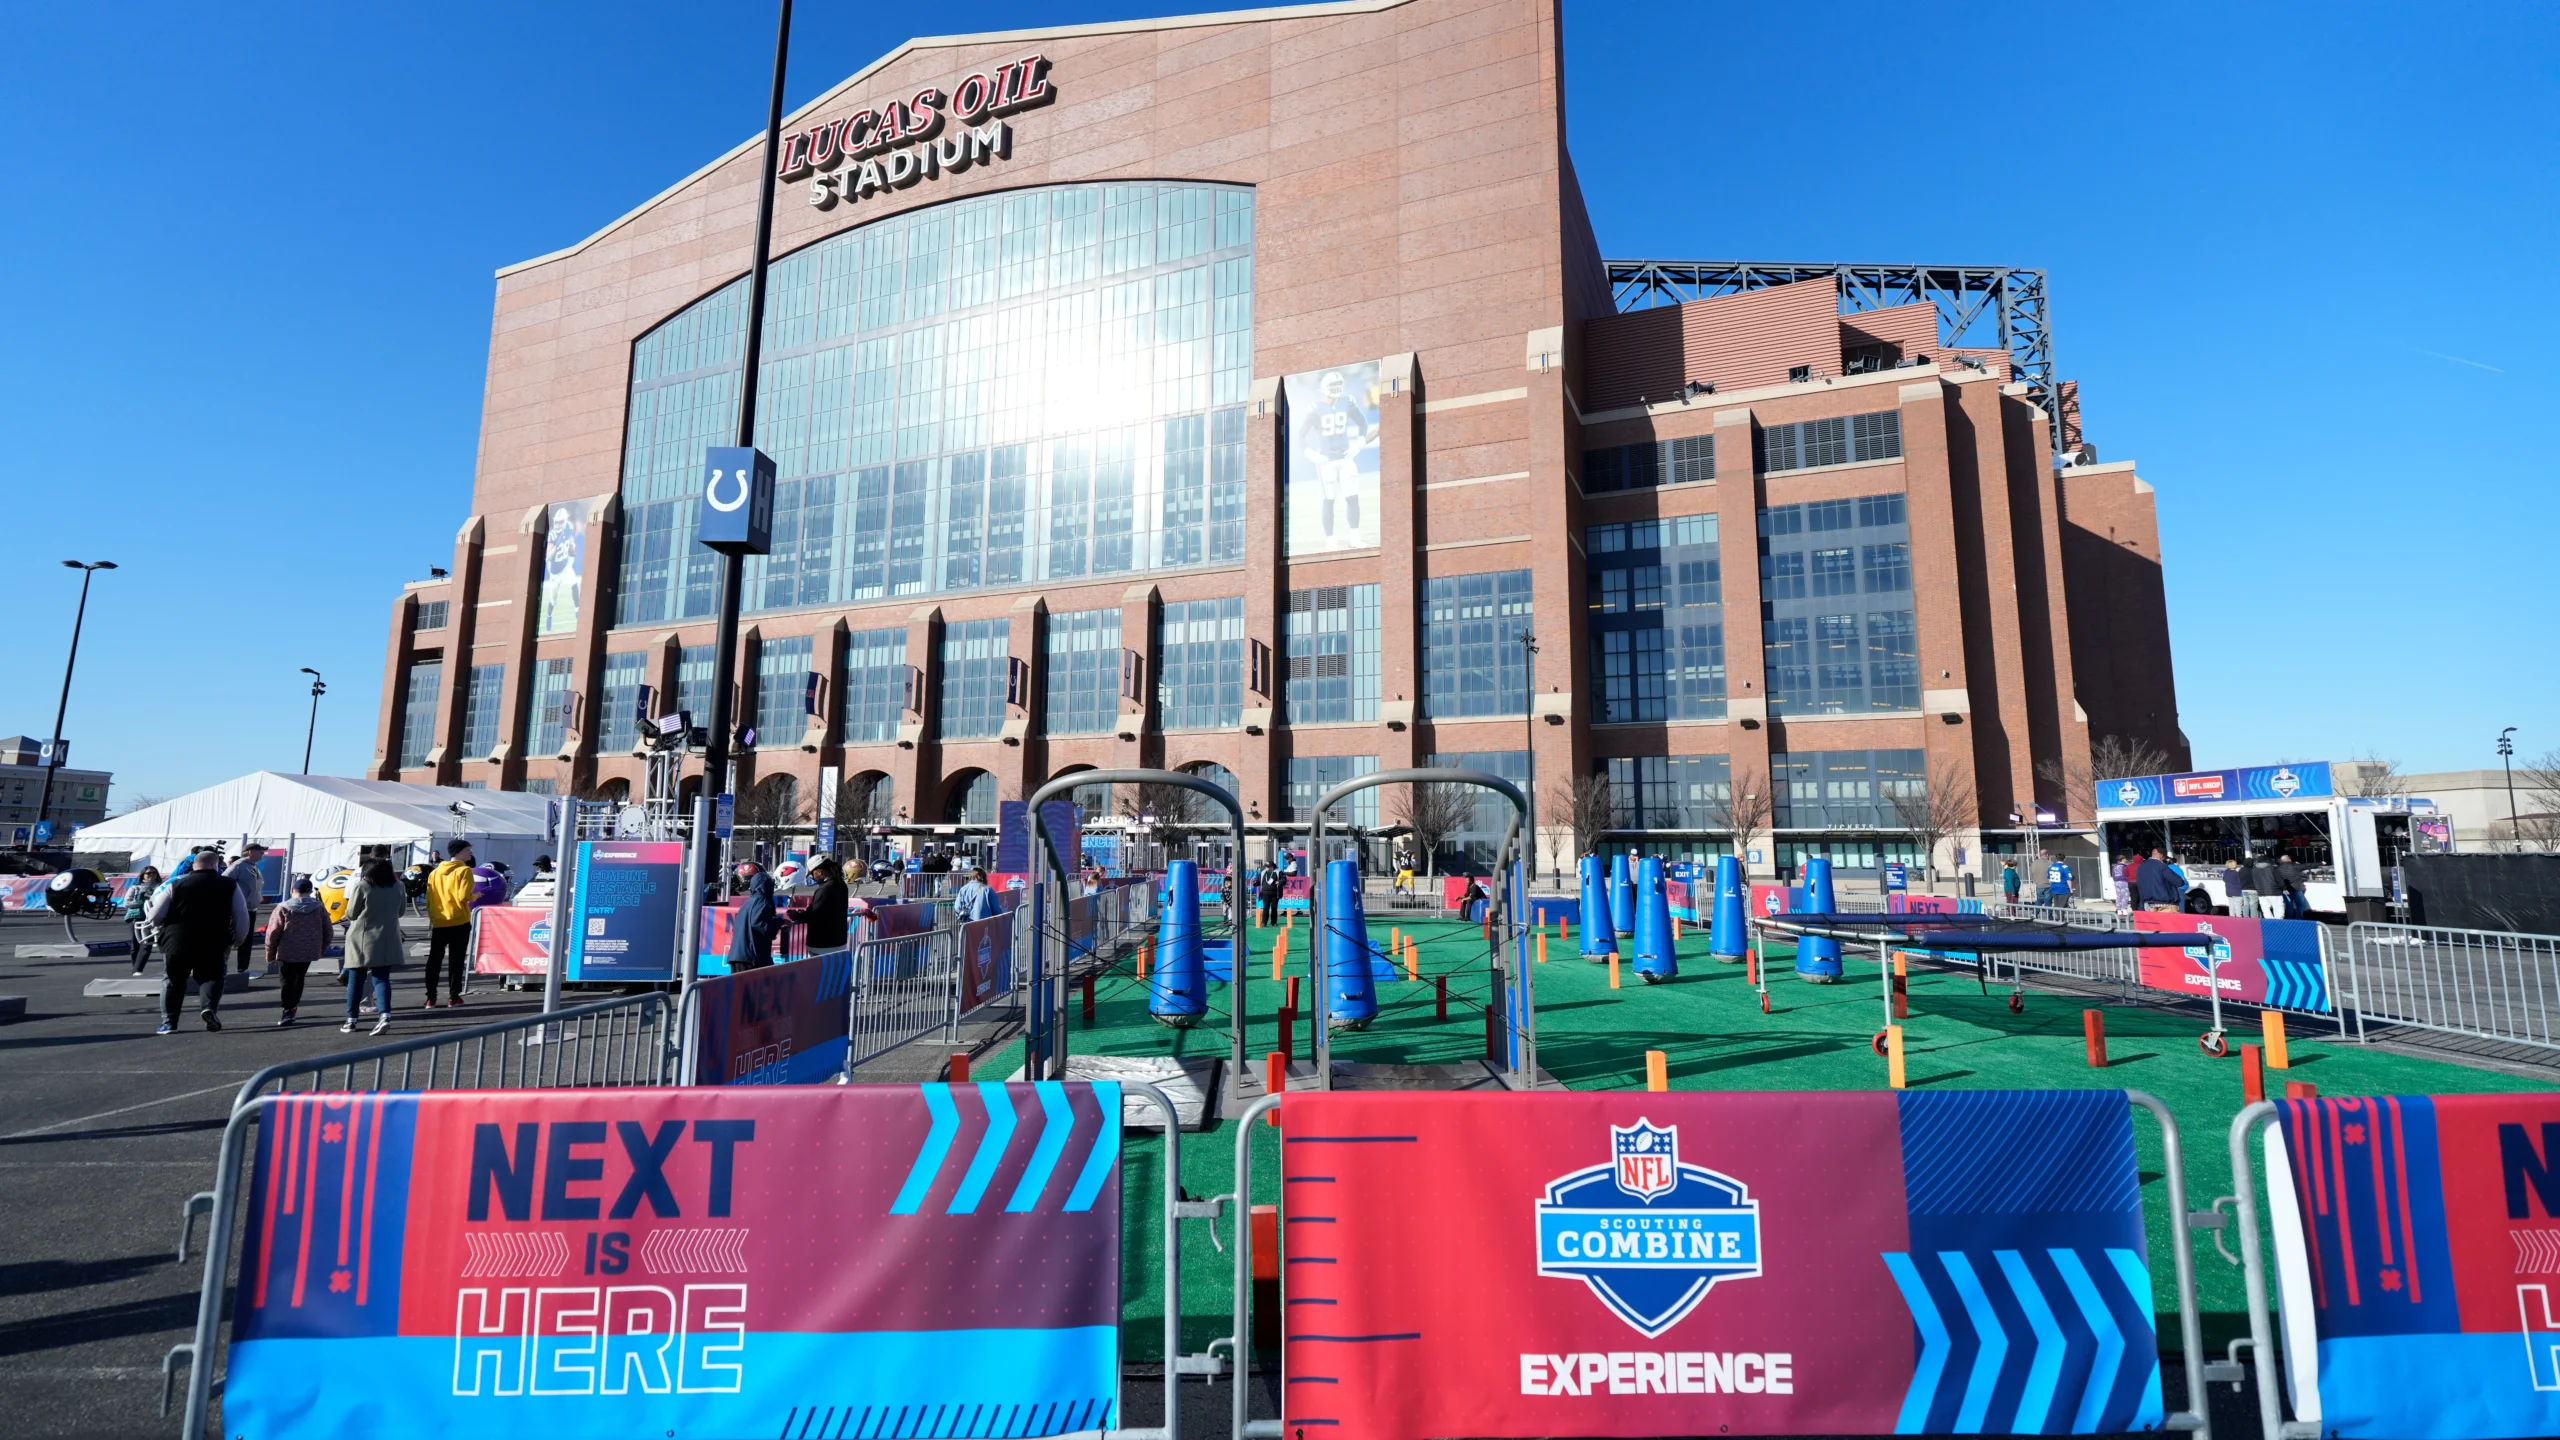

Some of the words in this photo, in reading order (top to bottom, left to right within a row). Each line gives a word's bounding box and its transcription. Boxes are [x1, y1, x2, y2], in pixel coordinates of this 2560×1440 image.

[777, 87, 937, 178] LUCAS
[951, 54, 1048, 120] OIL
[809, 119, 1003, 206] STADIUM
[1321, 411, 1348, 437] 99
[752, 468, 772, 534] H
[54, 744, 66, 762] K
[2202, 781, 2221, 789] SHOP
[1081, 836, 1116, 847] ENCH
[1400, 857, 1409, 866] 24
[590, 869, 648, 881] COMBINE
[1284, 879, 1304, 889] EXT
[589, 881, 657, 894] OBSTACLE
[588, 894, 641, 907] COURSE
[1909, 901, 1940, 914] NEXT
[588, 906, 616, 914] ENTRY
[2187, 946, 2228, 958] COMNE
[2184, 973, 2242, 991] EXPEENCE
[740, 970, 798, 1027] NEXT
[733, 1037, 792, 1087] HERE
[465, 1118, 755, 1223] NEXT
[1622, 1156, 1670, 1191] NFL
[1600, 1218, 1703, 1230] SCOUTING
[1556, 1230, 1741, 1259] COMBINE
[584, 1231, 631, 1277] IS
[451, 1282, 748, 1397] HERE
[1519, 1352, 1794, 1397] EXPERIENCE
